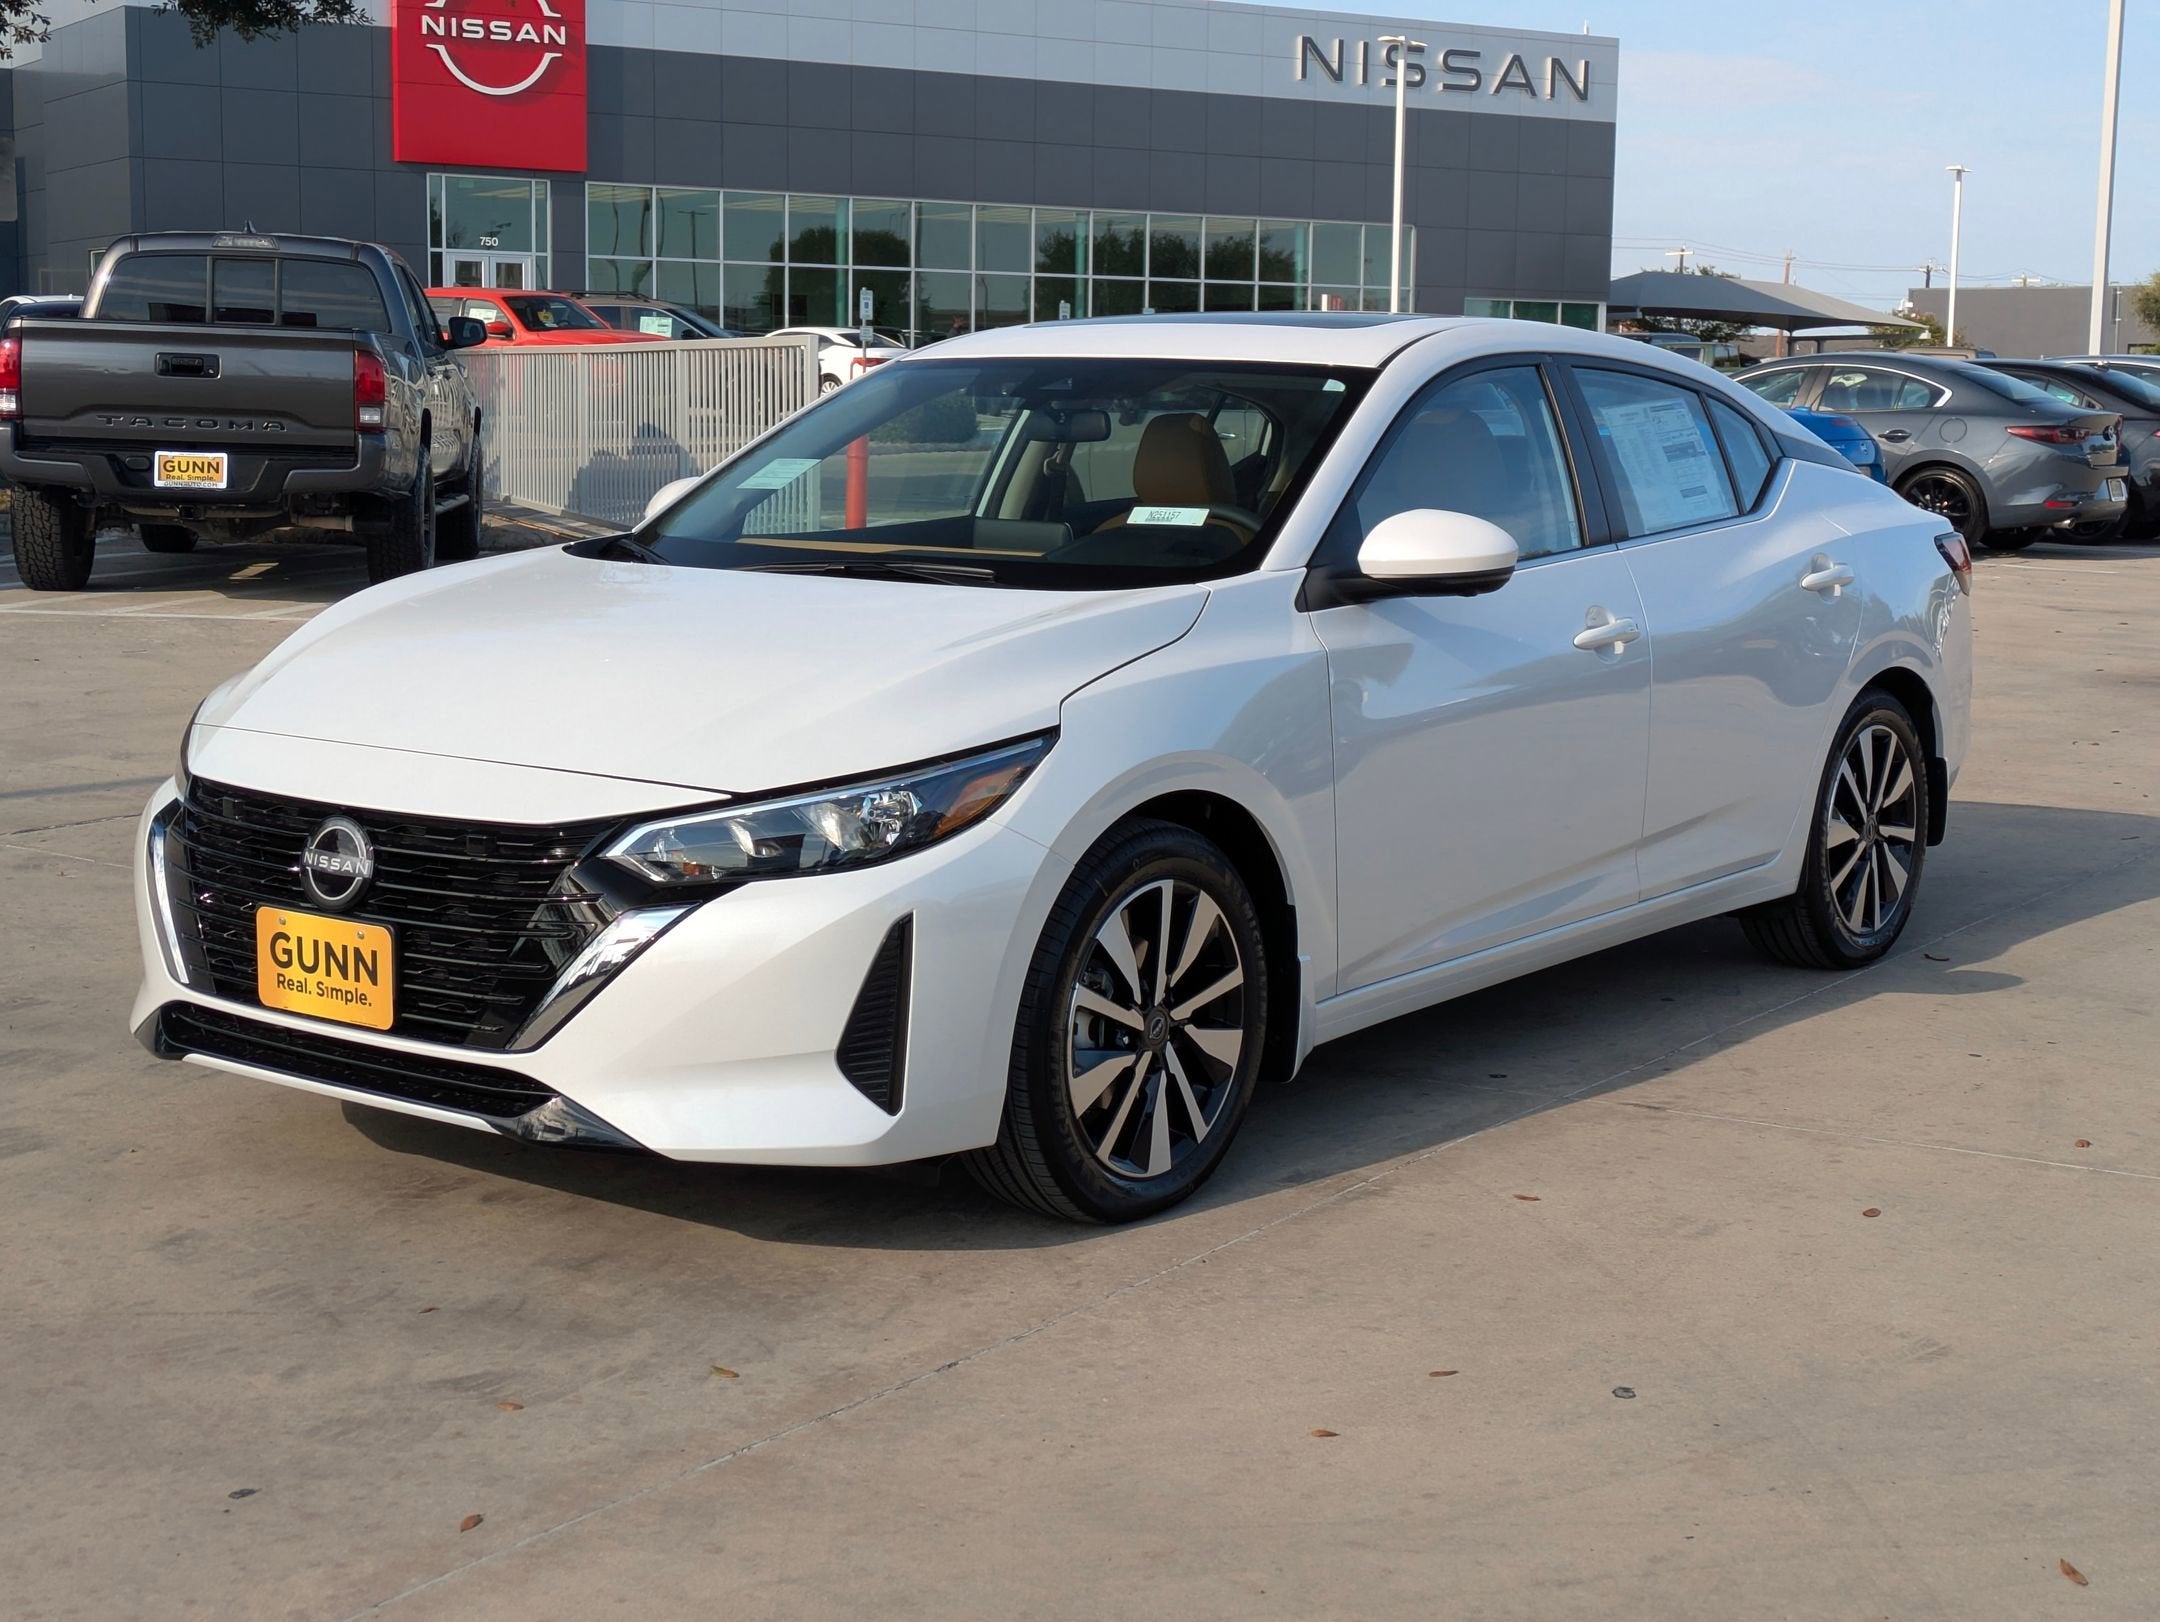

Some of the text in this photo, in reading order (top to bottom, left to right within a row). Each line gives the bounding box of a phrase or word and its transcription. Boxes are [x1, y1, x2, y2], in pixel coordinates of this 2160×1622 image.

[421, 15, 566, 45] NISSAN
[1298, 36, 1590, 101] NISSAN
[480, 236, 499, 247] 750
[96, 415, 287, 432] TACOMA
[163, 460, 220, 474] GUNN
[303, 851, 369, 875] NISSAN
[269, 931, 378, 987] GUNN
[277, 972, 312, 995] Real.
